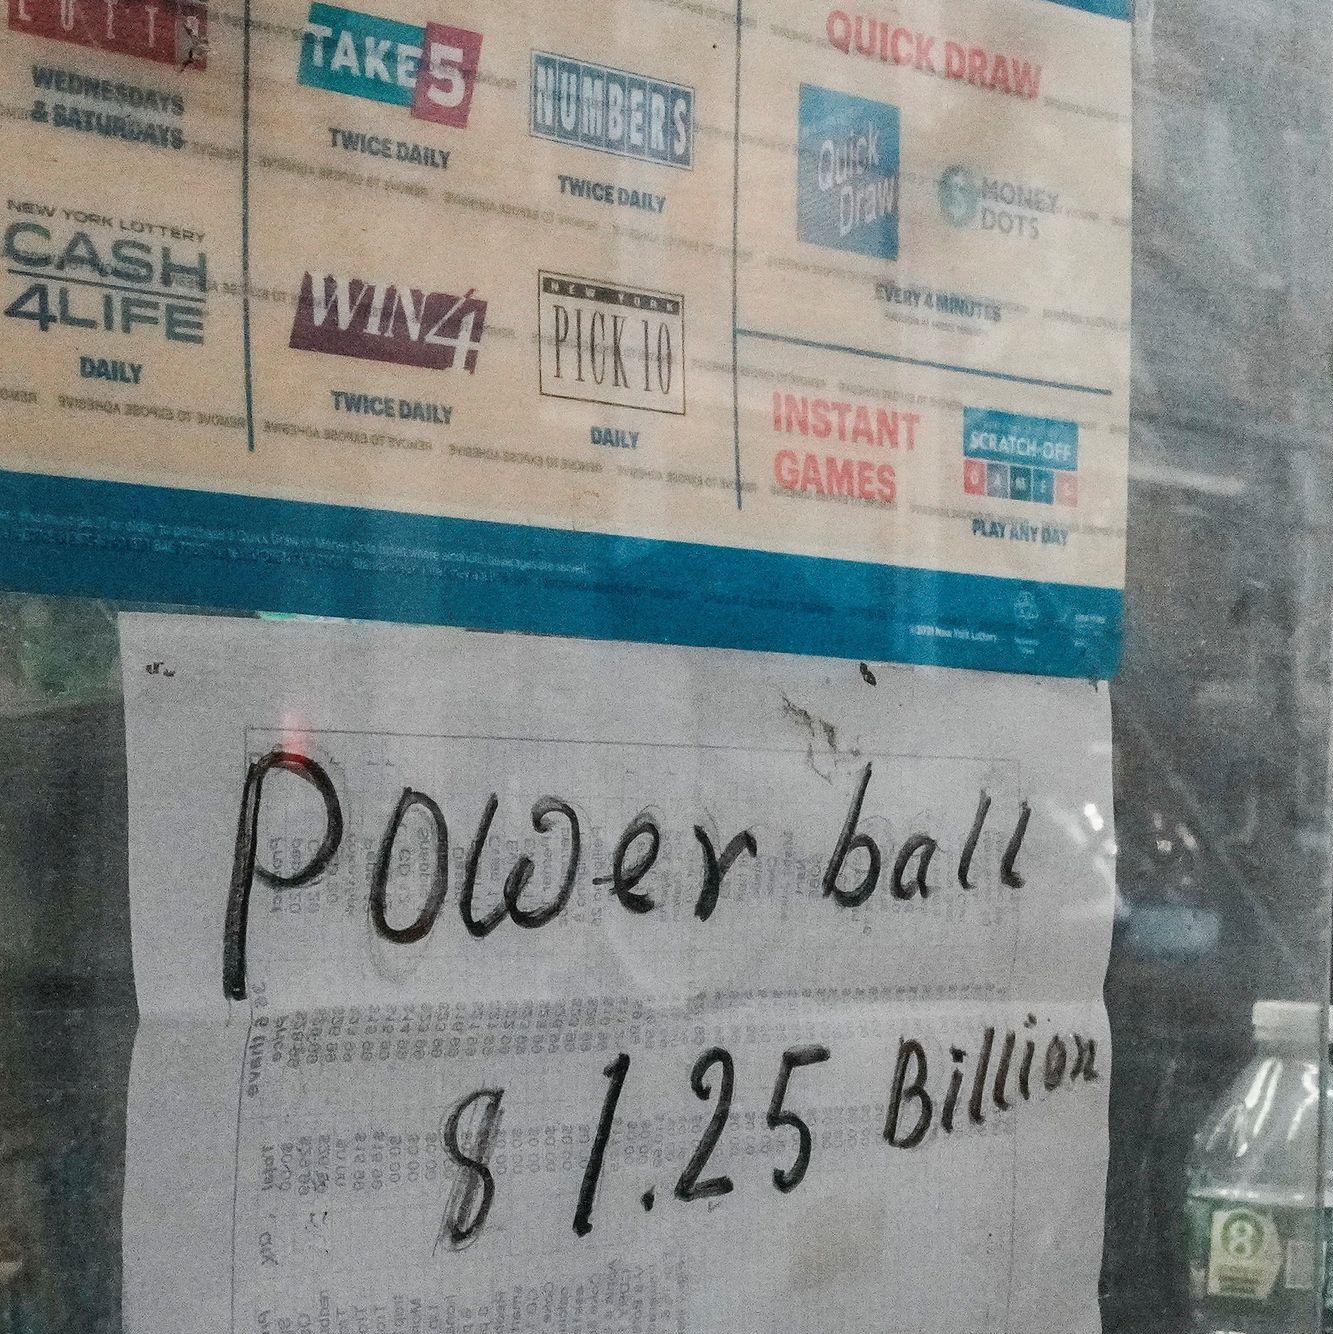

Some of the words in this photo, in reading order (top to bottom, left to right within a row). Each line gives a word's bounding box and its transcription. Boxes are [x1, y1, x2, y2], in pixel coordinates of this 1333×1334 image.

[305, 22, 420, 83] TAKE
[427, 43, 468, 107] 5
[825, 10, 937, 71] QUICK
[944, 41, 1043, 100] DRAW
[32, 66, 184, 116] WEDNESDAYS
[537, 65, 687, 156] NUMBERS
[31, 100, 47, 122] &
[53, 103, 186, 149] SATURDAYS
[329, 127, 393, 159] TWICE
[396, 140, 451, 170] DAILY
[817, 123, 880, 192] Quick
[558, 174, 615, 205] TWICE
[617, 188, 666, 214] DAILY
[838, 175, 899, 238] Draw
[981, 177, 1059, 215] MONEY
[5, 201, 55, 218] NEW
[62, 207, 114, 230] YORK
[120, 217, 206, 242] LOTTERY
[981, 206, 1039, 239] DOTS
[2, 221, 207, 291] CASH
[549, 278, 596, 298] NEW
[2, 282, 205, 346] 4LIFE
[79, 355, 142, 385] DAILY
[553, 304, 629, 389] PICK
[642, 308, 673, 396] 10
[330, 390, 396, 419] TWICE
[399, 397, 453, 425] DAILY
[772, 392, 921, 450] INSTANT
[590, 425, 639, 450] DAILY
[969, 432, 1073, 464] SCRATCH-OFF
[773, 450, 897, 502] GAMES
[972, 518, 1006, 540] PLAY
[823, 762, 1032, 908] ball
[883, 1016, 1101, 1148] Billion
